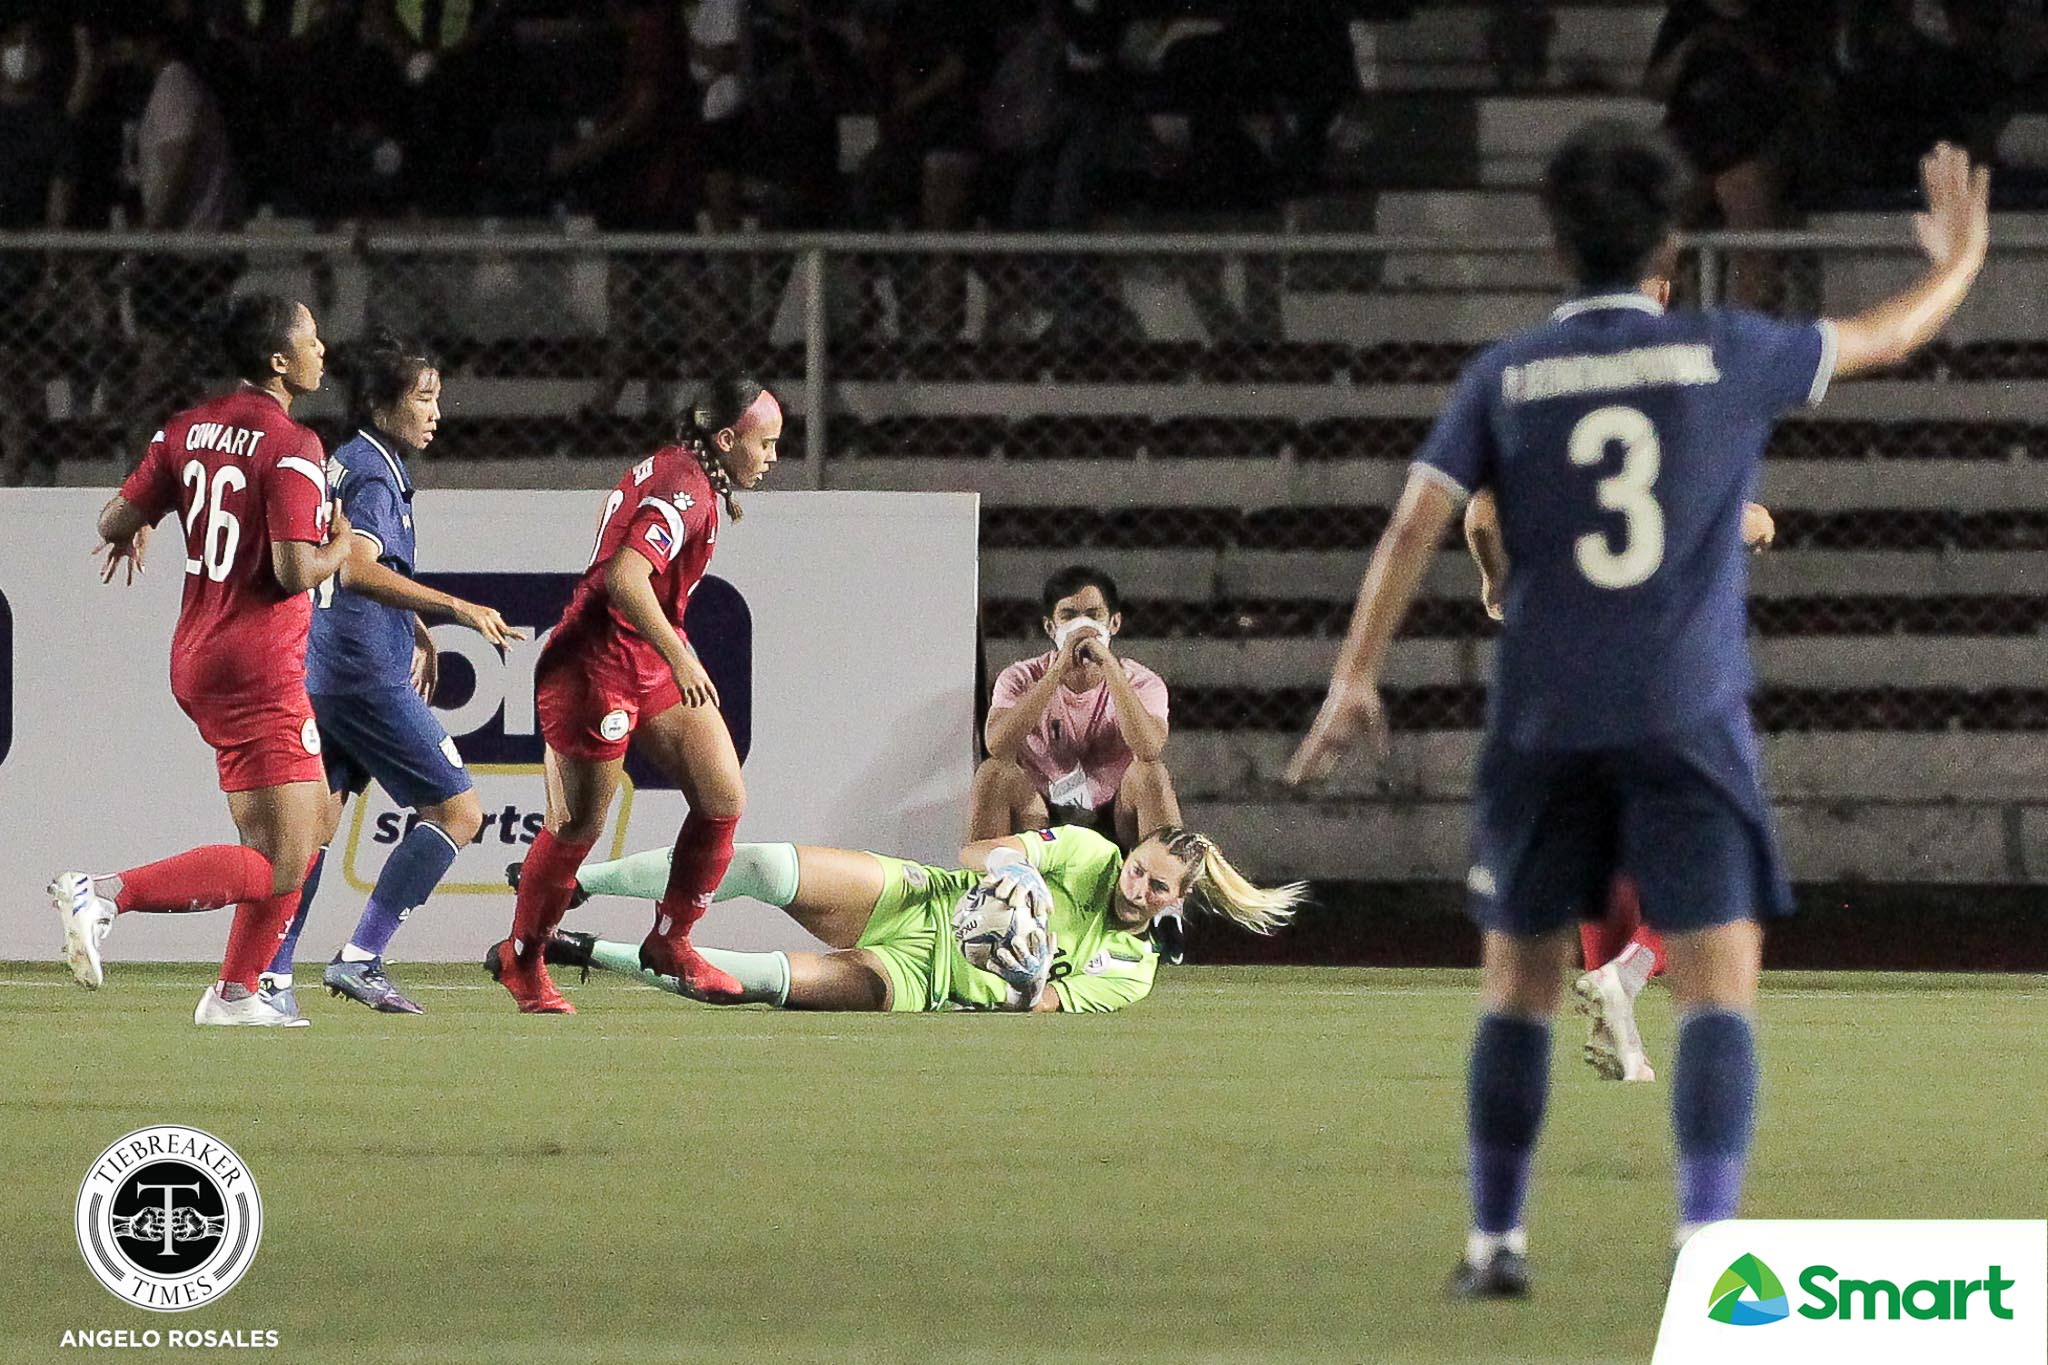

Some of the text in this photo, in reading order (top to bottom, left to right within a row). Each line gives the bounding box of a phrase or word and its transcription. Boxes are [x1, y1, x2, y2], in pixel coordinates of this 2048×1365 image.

[184, 422, 265, 457] COWART
[182, 458, 247, 583] 26
[1567, 405, 1666, 589] 3
[373, 806, 546, 845] srts
